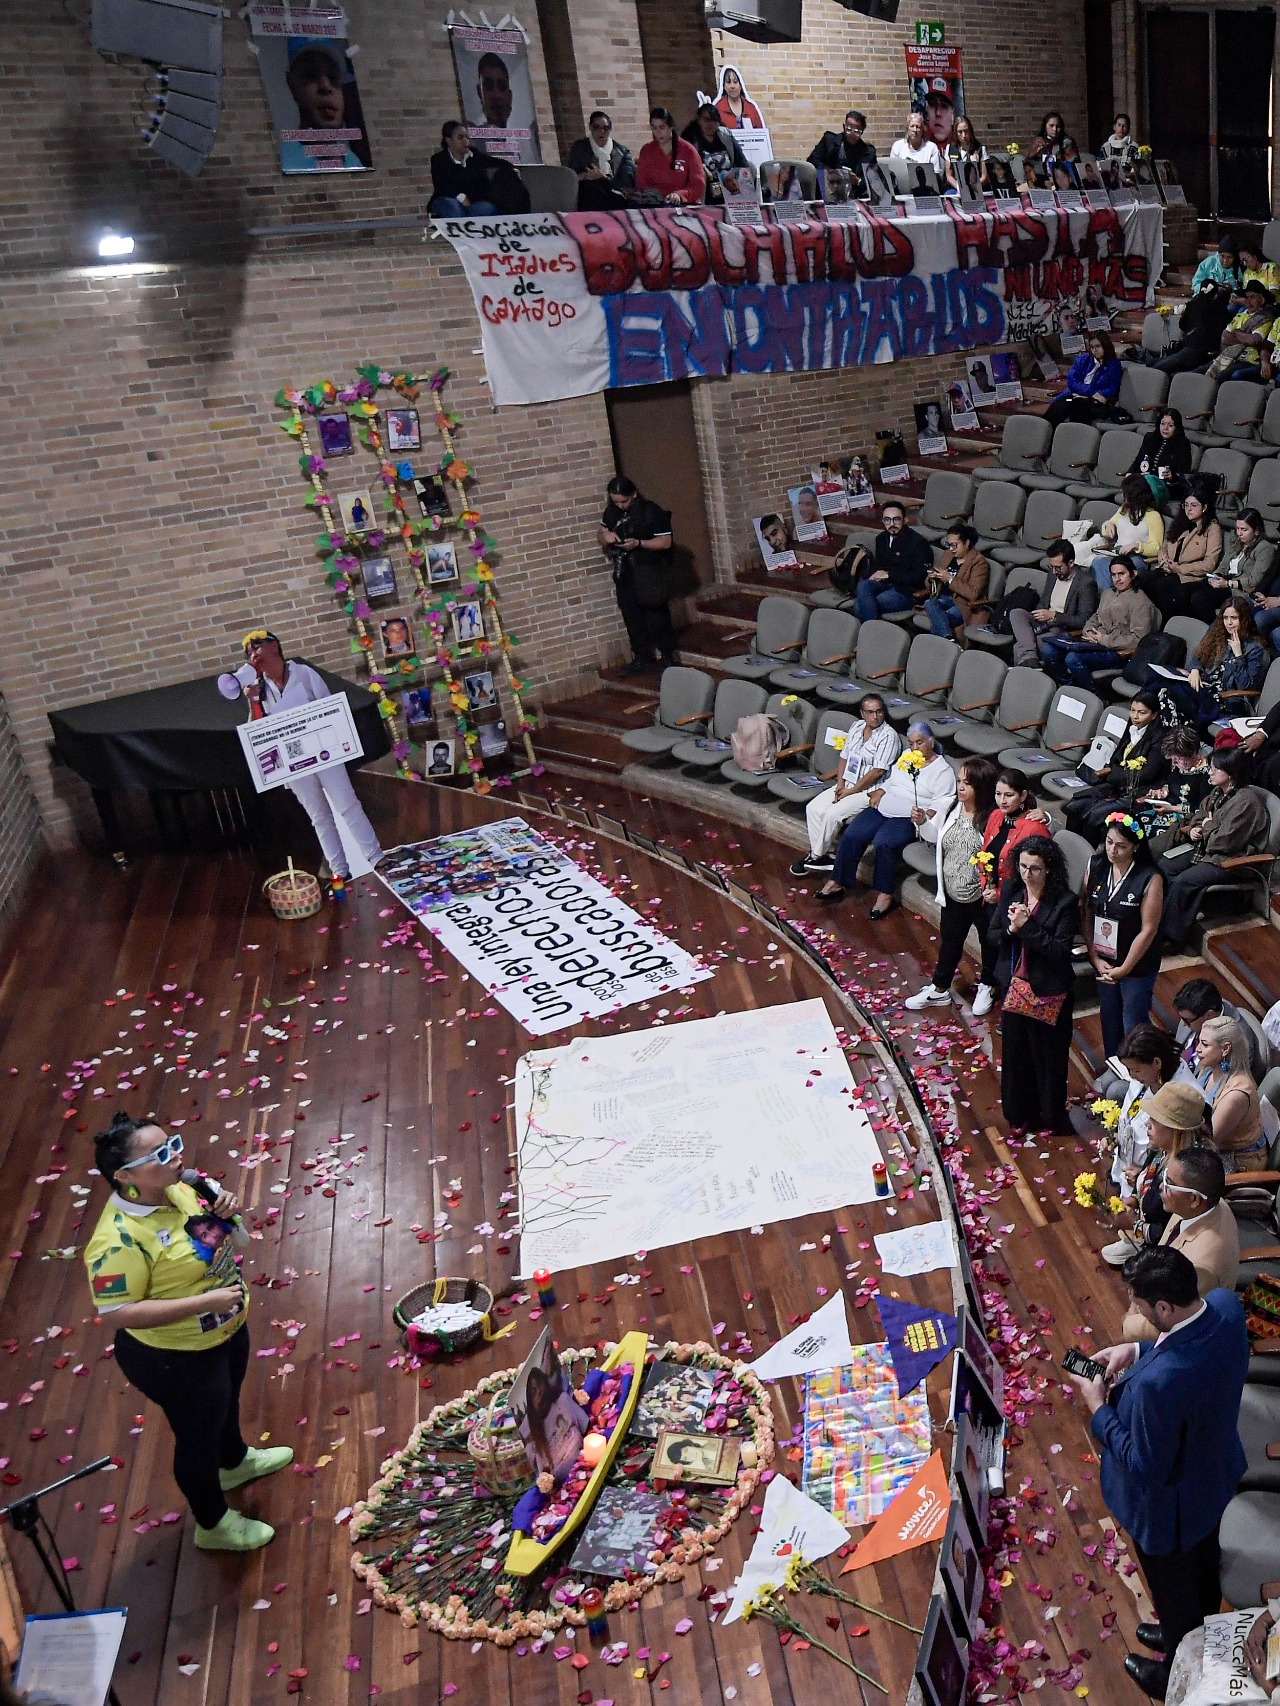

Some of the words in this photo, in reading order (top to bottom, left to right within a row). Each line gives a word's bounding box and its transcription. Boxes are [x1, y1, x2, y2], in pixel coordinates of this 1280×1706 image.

[908, 46, 956, 55] DESAPARECIDO
[499, 238, 531, 254] de
[513, 275, 544, 296] de
[481, 295, 577, 328] Cartago
[513, 856, 671, 979] buscadoras
[444, 902, 511, 961] integral
[484, 884, 618, 989] derechos
[495, 955, 538, 987] ley
[644, 971, 663, 983] de
[660, 966, 680, 979] las
[590, 984, 617, 1002] por
[607, 978, 628, 994] los
[522, 980, 573, 1021] Una
